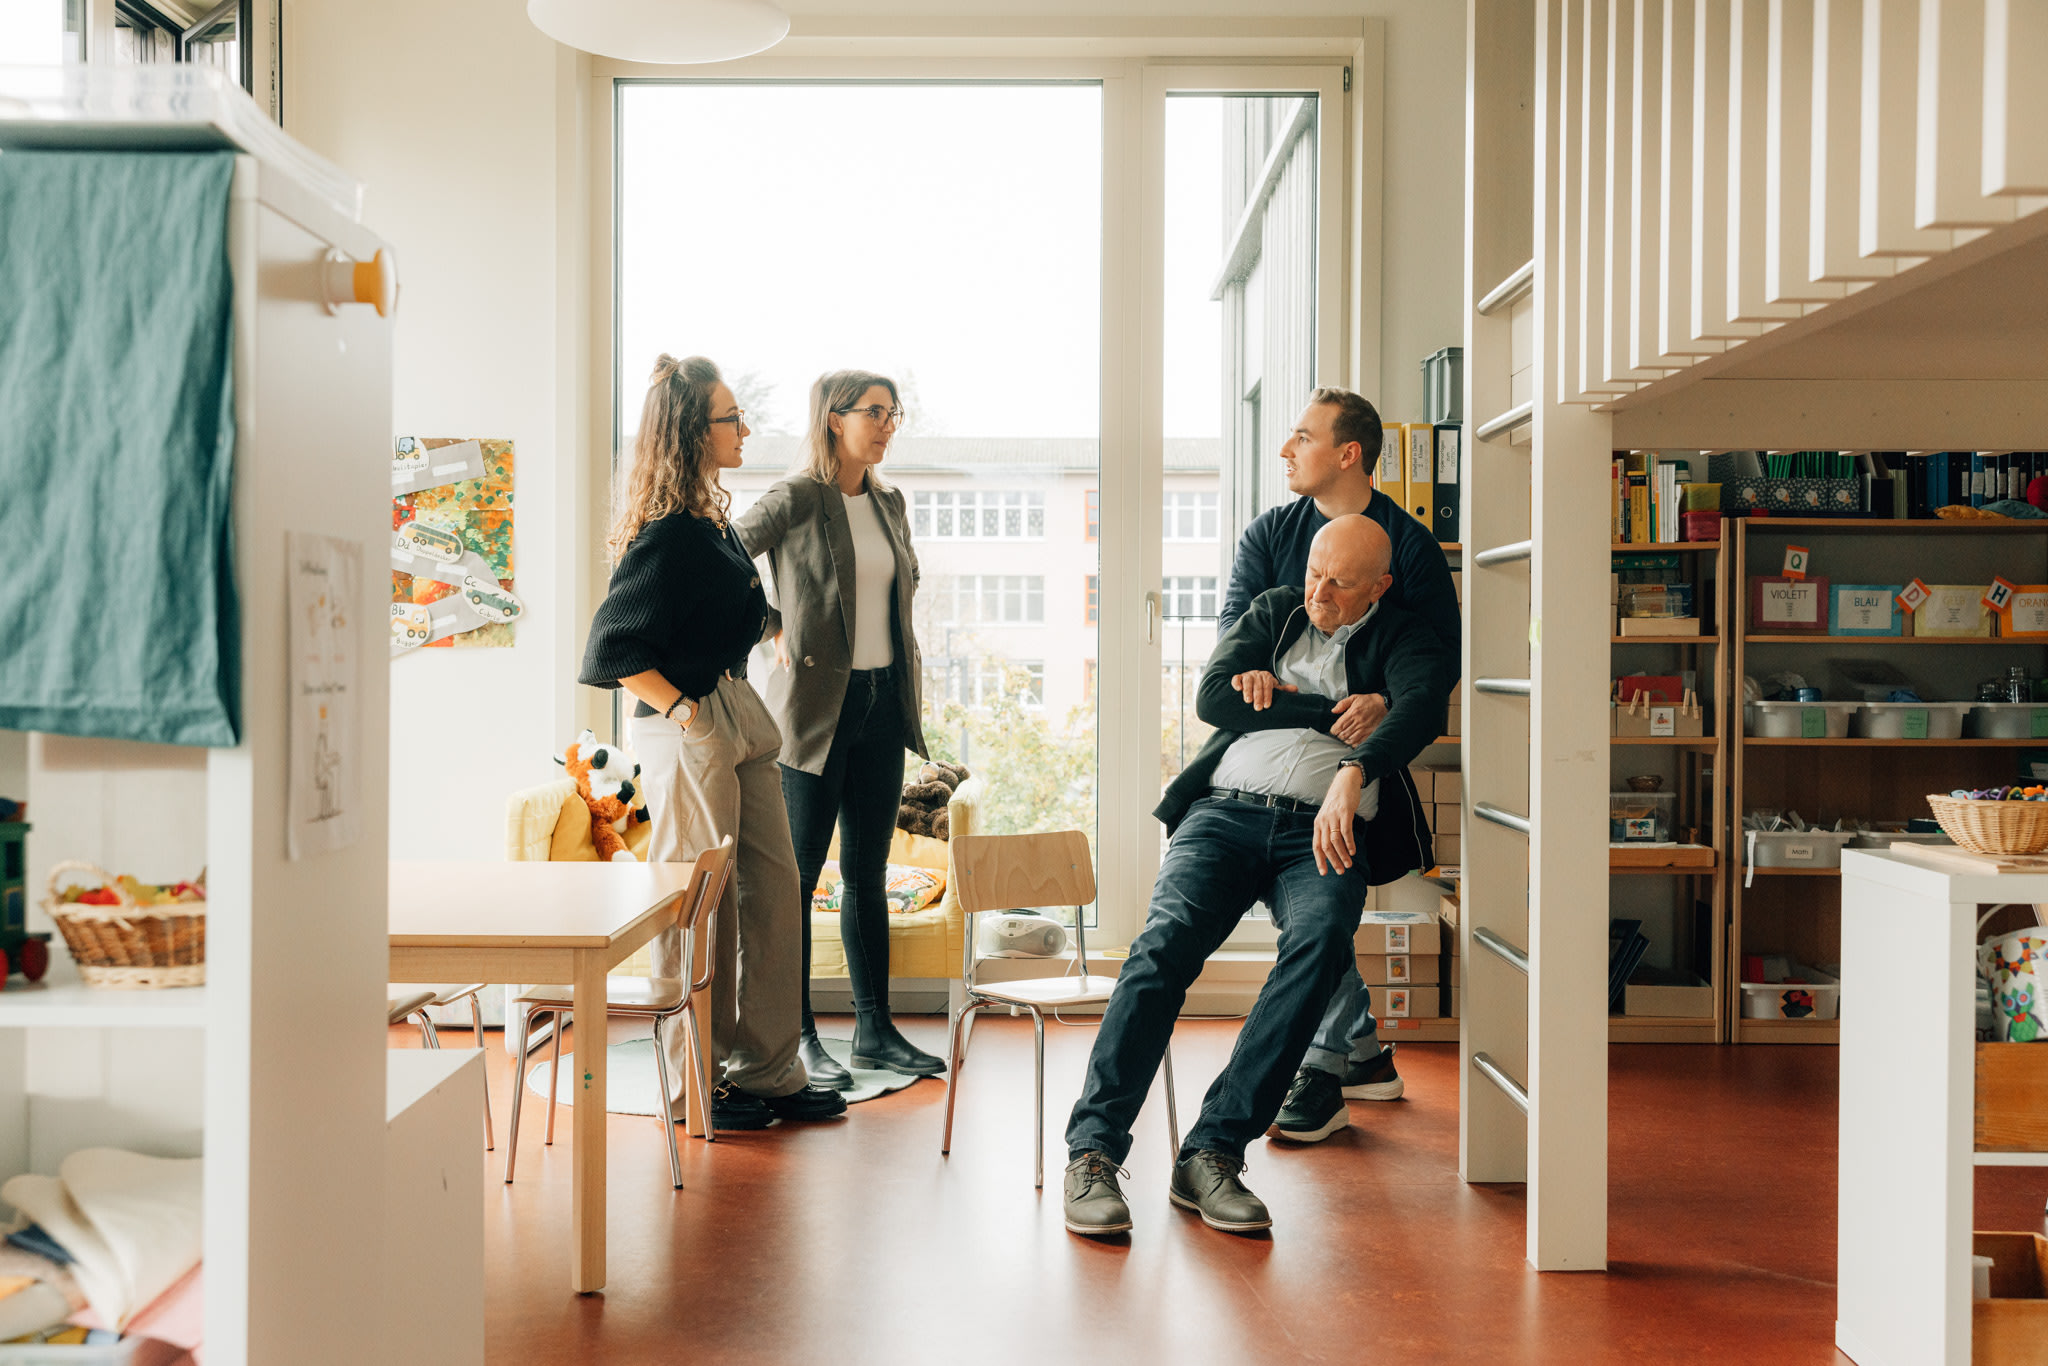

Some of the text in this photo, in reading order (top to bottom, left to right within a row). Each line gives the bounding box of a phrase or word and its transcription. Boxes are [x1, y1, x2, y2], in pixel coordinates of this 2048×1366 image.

[397, 537, 410, 550] Dd
[1790, 553, 1802, 569] Q
[463, 575, 477, 588] Cc
[1770, 589, 1809, 600] VIOLETT
[1905, 587, 1920, 602] D
[1991, 585, 2007, 604] H
[1854, 597, 1880, 607] BLAU
[2018, 598, 2048, 609] ORAN
[391, 603, 406, 616] Bb
